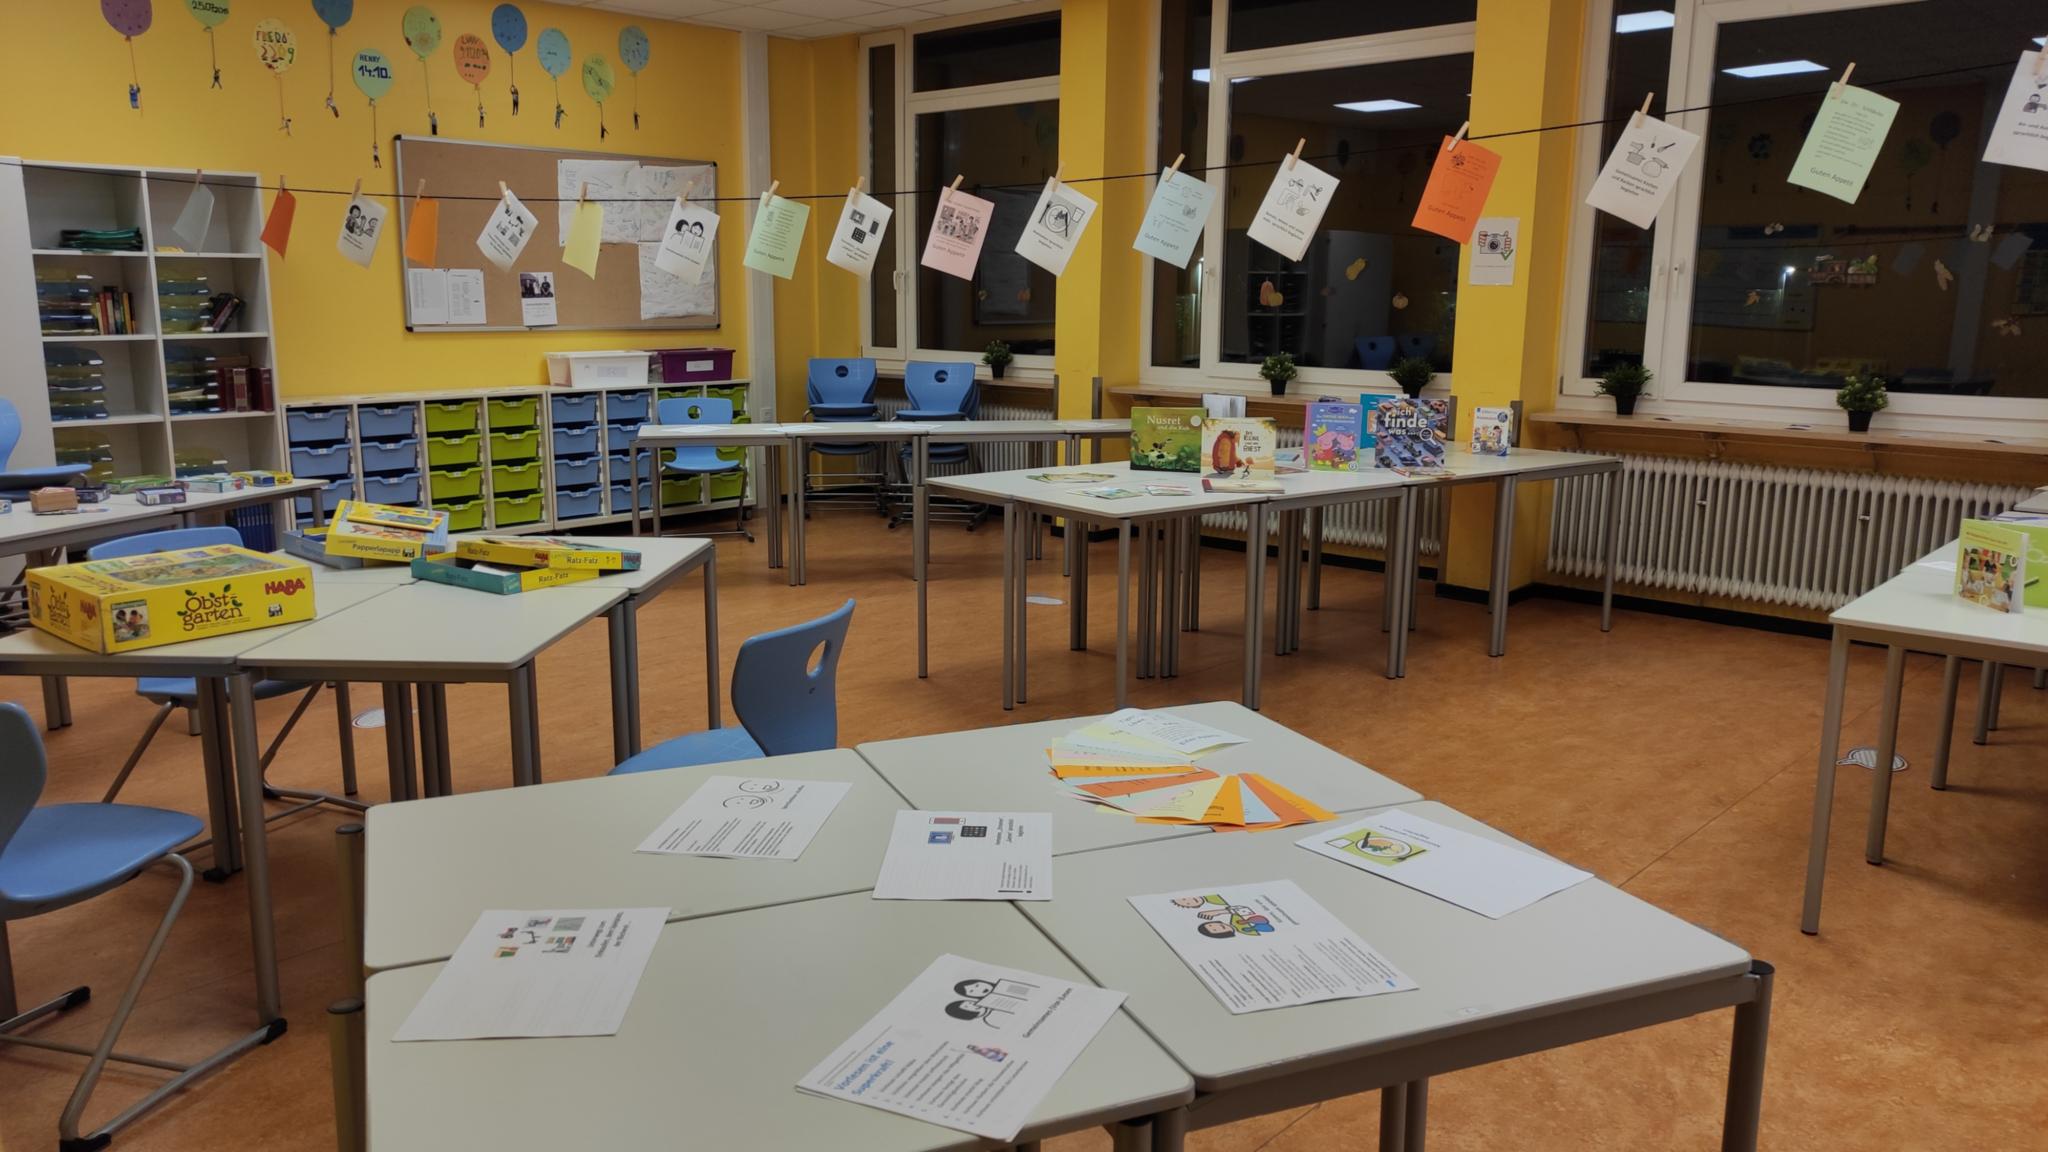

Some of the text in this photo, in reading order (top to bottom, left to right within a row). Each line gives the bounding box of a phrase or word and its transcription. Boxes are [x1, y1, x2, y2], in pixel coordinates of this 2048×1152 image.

[359, 54, 381, 64] HENRY
[357, 64, 392, 80] 14.10.
[1810, 166, 1854, 186] Guten Appetit
[1427, 204, 1446, 215] Guten
[1144, 232, 1161, 243] Guten
[1146, 415, 1181, 425] Nusret
[1384, 412, 1428, 428] finde
[352, 543, 402, 555] Papperlapapp
[566, 555, 599, 565] Ratz-Fatz
[538, 571, 569, 584] Ratz-Fatz
[264, 578, 306, 597] HABA
[182, 606, 244, 632] garten
[833, 1063, 870, 1090] Vorlesen
[876, 1041, 895, 1056] eine
[851, 1059, 897, 1097] Superkraft!
